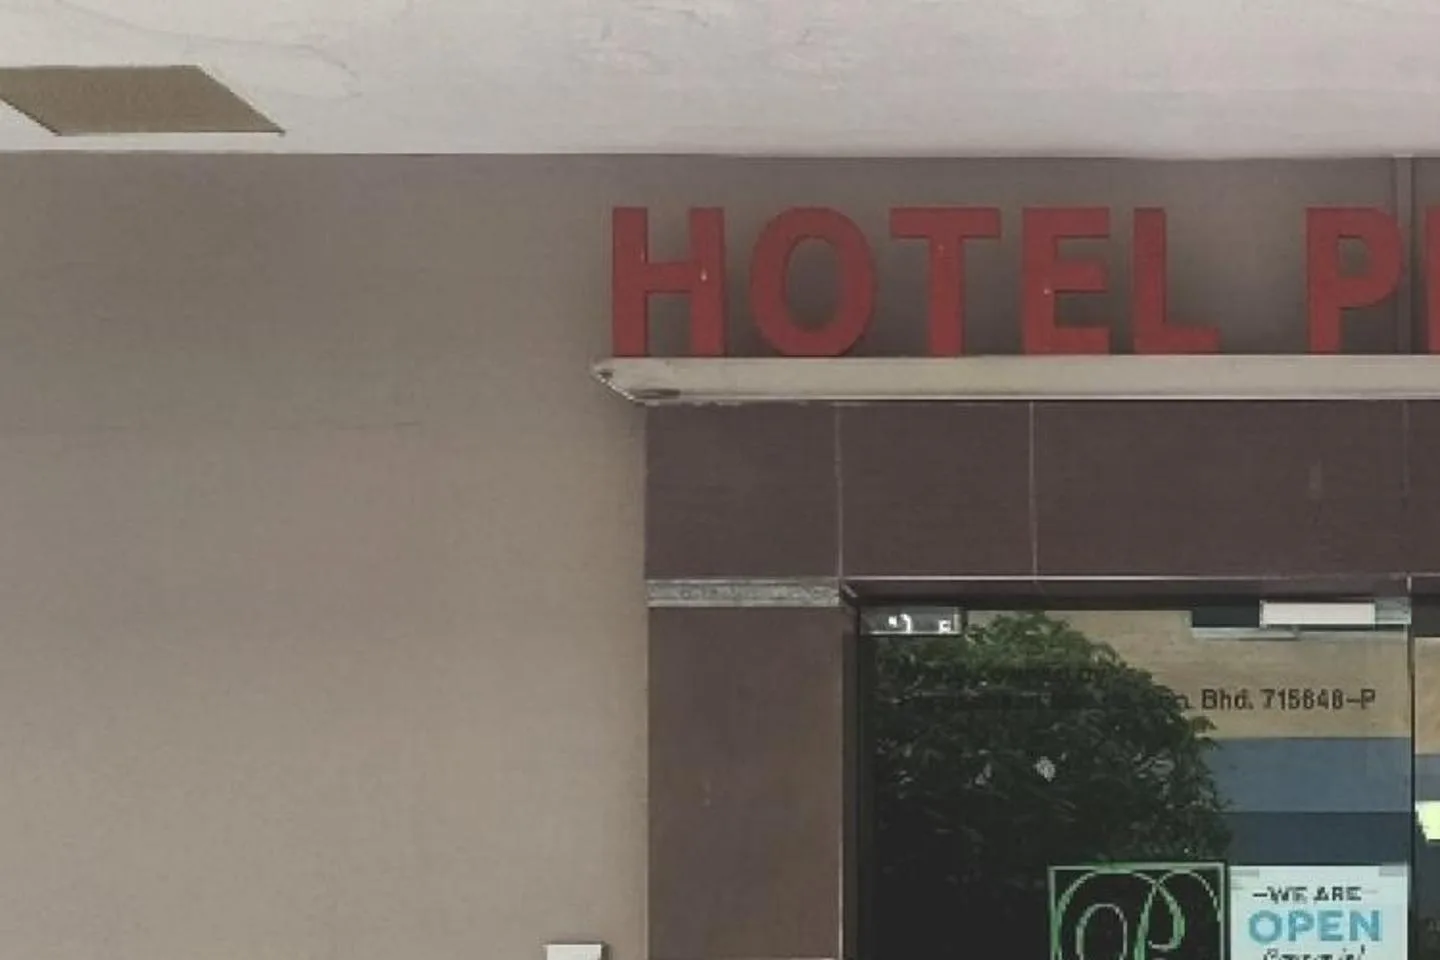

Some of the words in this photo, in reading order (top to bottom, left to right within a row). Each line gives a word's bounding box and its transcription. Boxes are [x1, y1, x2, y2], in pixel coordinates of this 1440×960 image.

[611, 206, 1222, 357] HOTEL
[1201, 688, 1254, 710] Bhd.
[1267, 886, 1307, 903] WE
[1312, 886, 1362, 902] ARE
[1248, 909, 1381, 944] OPEN
